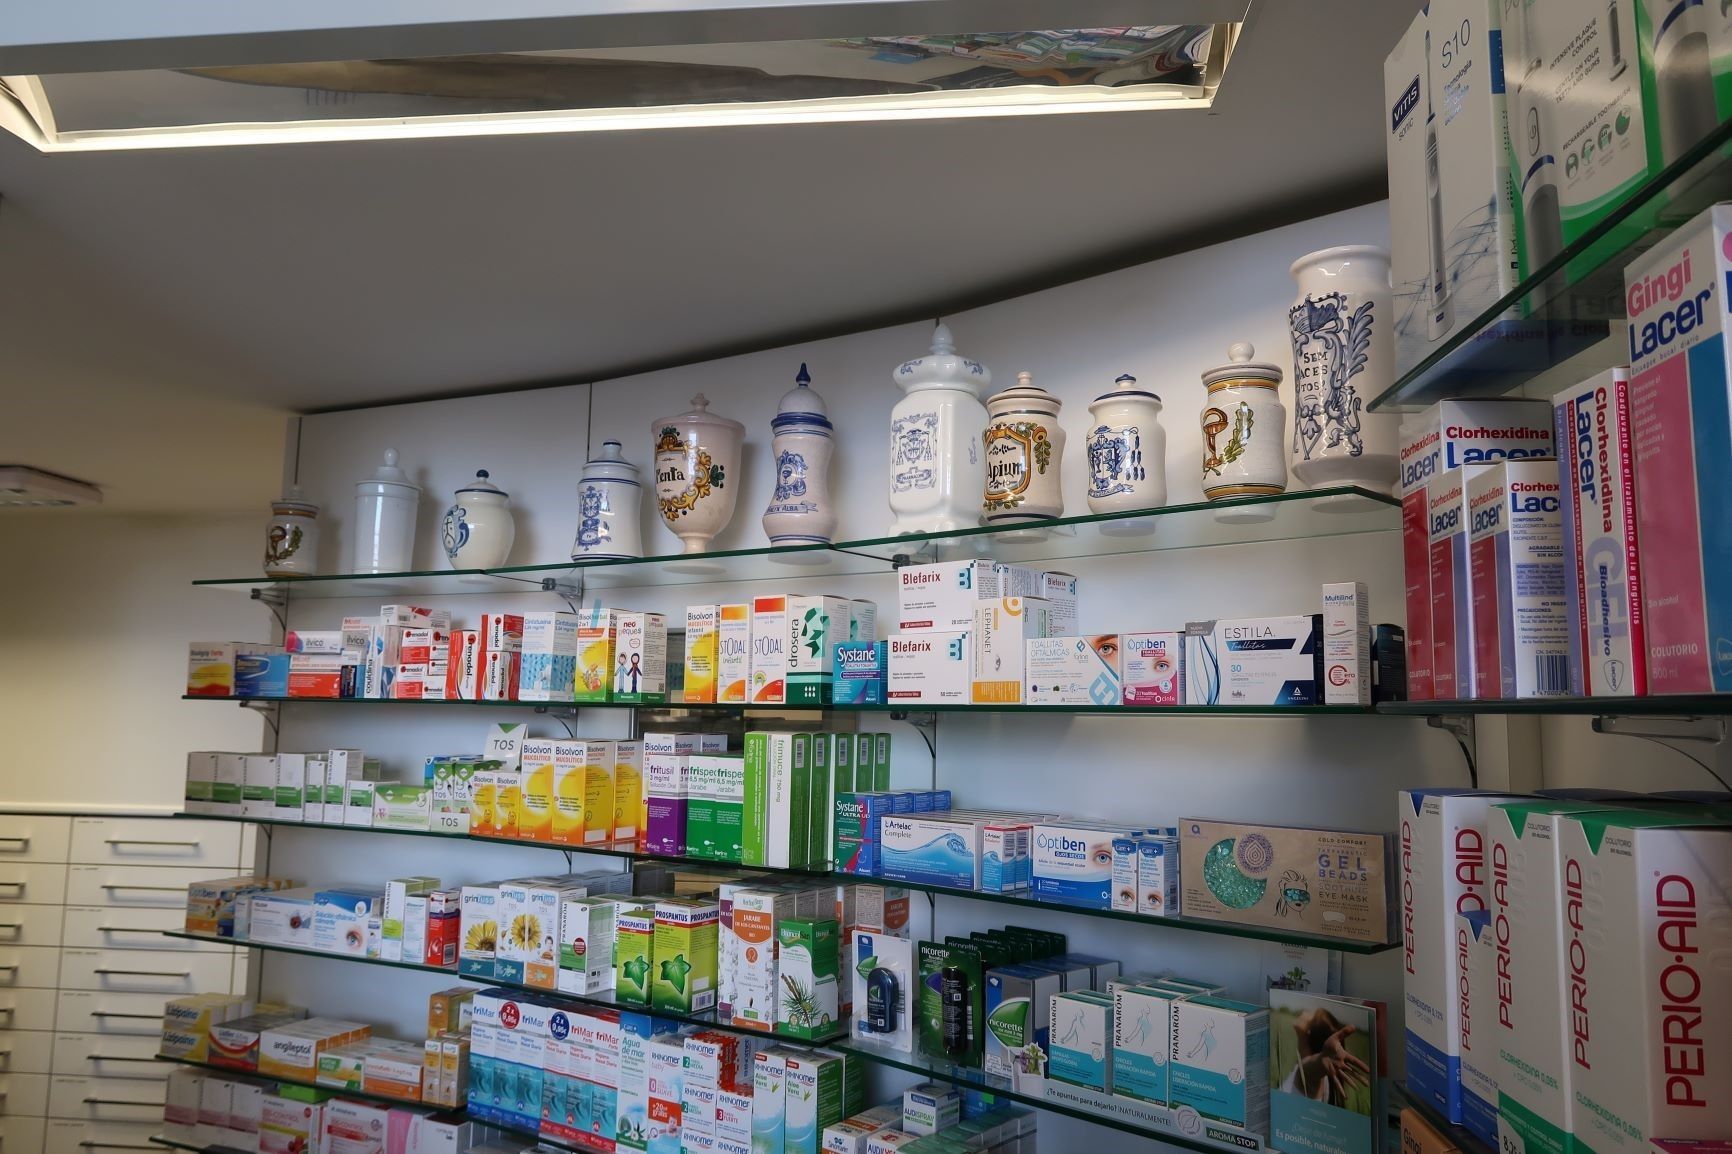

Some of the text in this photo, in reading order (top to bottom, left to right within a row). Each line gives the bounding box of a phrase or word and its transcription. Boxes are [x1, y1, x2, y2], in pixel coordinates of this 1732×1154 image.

[1441, 18, 1471, 69] S10
[1571, 29, 1598, 57] CONTROL
[1584, 47, 1600, 67] YOUR
[1584, 57, 1601, 78] GUMS
[1394, 86, 1418, 122] VITIS
[1628, 249, 1692, 318] Gingi
[1629, 287, 1711, 363] Lacer
[1616, 384, 1629, 450] Coadyuvante
[1446, 427, 1550, 440] Clorhexidina
[1400, 431, 1440, 461] Clorhexidina
[1575, 390, 1597, 500] Lacer
[1595, 386, 1613, 533] Clorhexidina
[1622, 453, 1630, 466] en
[988, 460, 1024, 484] Apium
[1401, 450, 1439, 488] Lacer
[1430, 487, 1463, 509] Clorhexidina
[1469, 486, 1504, 508] Clorhexidina
[1512, 493, 1561, 513] Lac
[1624, 482, 1635, 542] tratamiento
[1430, 505, 1462, 535] Lacer
[1470, 504, 1502, 535] Lacer
[1628, 545, 1636, 558] de
[903, 571, 941, 585] Blefarix
[1047, 577, 1067, 587] Blefarix
[1585, 537, 1629, 657] GEL
[1629, 575, 1641, 625] gingivitis
[687, 612, 714, 621] Bisolvon
[1599, 565, 1612, 656] Bioadhesivo
[618, 628, 643, 637] peques
[984, 607, 992, 654] LEPHANET
[1224, 626, 1273, 639] ESTILA
[346, 633, 365, 646] ilvico
[754, 635, 784, 656] STODAL
[788, 618, 799, 668] drosera
[1030, 639, 1064, 648] TOALLITAS
[1127, 638, 1166, 651] Optiben
[719, 637, 747, 656] STODAL
[892, 640, 931, 653] Blefarix
[1651, 644, 1698, 658] COLUTORIO
[837, 647, 876, 667] Systane
[1230, 664, 1242, 673] 30
[493, 739, 514, 750] TOS
[523, 744, 552, 754] Bisolvon
[555, 746, 584, 756] Bisolvon
[644, 742, 672, 752] Bisolvon
[702, 741, 720, 749] Bisolvon
[777, 739, 785, 776] frimuce
[650, 765, 675, 775] fritusil
[473, 775, 494, 784] Bisolvon
[497, 777, 518, 785] Bisolvon
[654, 775, 670, 783] mg/ml
[697, 776, 717, 785] mg/ml
[454, 791, 467, 799] TOS
[775, 792, 781, 803] mg
[836, 800, 864, 814] Systane
[440, 817, 459, 827] TOS
[888, 821, 912, 831] Artelac
[884, 829, 912, 839] Complete
[1036, 833, 1086, 852] Optiben
[1604, 836, 1632, 848] COLUTORIO
[1318, 854, 1367, 872] GEL
[1318, 869, 1368, 882] BEADS
[1318, 891, 1369, 903] EYE MASK
[655, 910, 689, 922] PROSPANTUS
[619, 919, 648, 930] PROSPANTUS
[921, 945, 950, 958] nicorette
[473, 1006, 495, 1018] friMar
[522, 1015, 544, 1027] friMar
[989, 1019, 1023, 1032] nicorette
[571, 1024, 594, 1038] friMar
[596, 1031, 619, 1045] friMar
[622, 1036, 641, 1049] Agua
[621, 1046, 645, 1058] de mar
[685, 1058, 690, 1066] 2
[755, 1073, 768, 1081] Aloe
[755, 1079, 768, 1087] Vera
[651, 1080, 656, 1090] 0
[787, 1080, 800, 1088] Aloe
[787, 1087, 800, 1096] Vera
[1046, 1087, 1056, 1097] ¿Te
[1056, 1090, 1080, 1103] apuntas
[1080, 1096, 1093, 1107] para
[1093, 1097, 1117, 1113] dejarlo?
[683, 1103, 689, 1111] 2
[718, 1110, 723, 1119] 3
[904, 1107, 935, 1122] AUDISPRAY
[1208, 1129, 1256, 1148] AROMA STOP
[1275, 1128, 1284, 1138] Es
[1284, 1132, 1313, 1148] posible,
